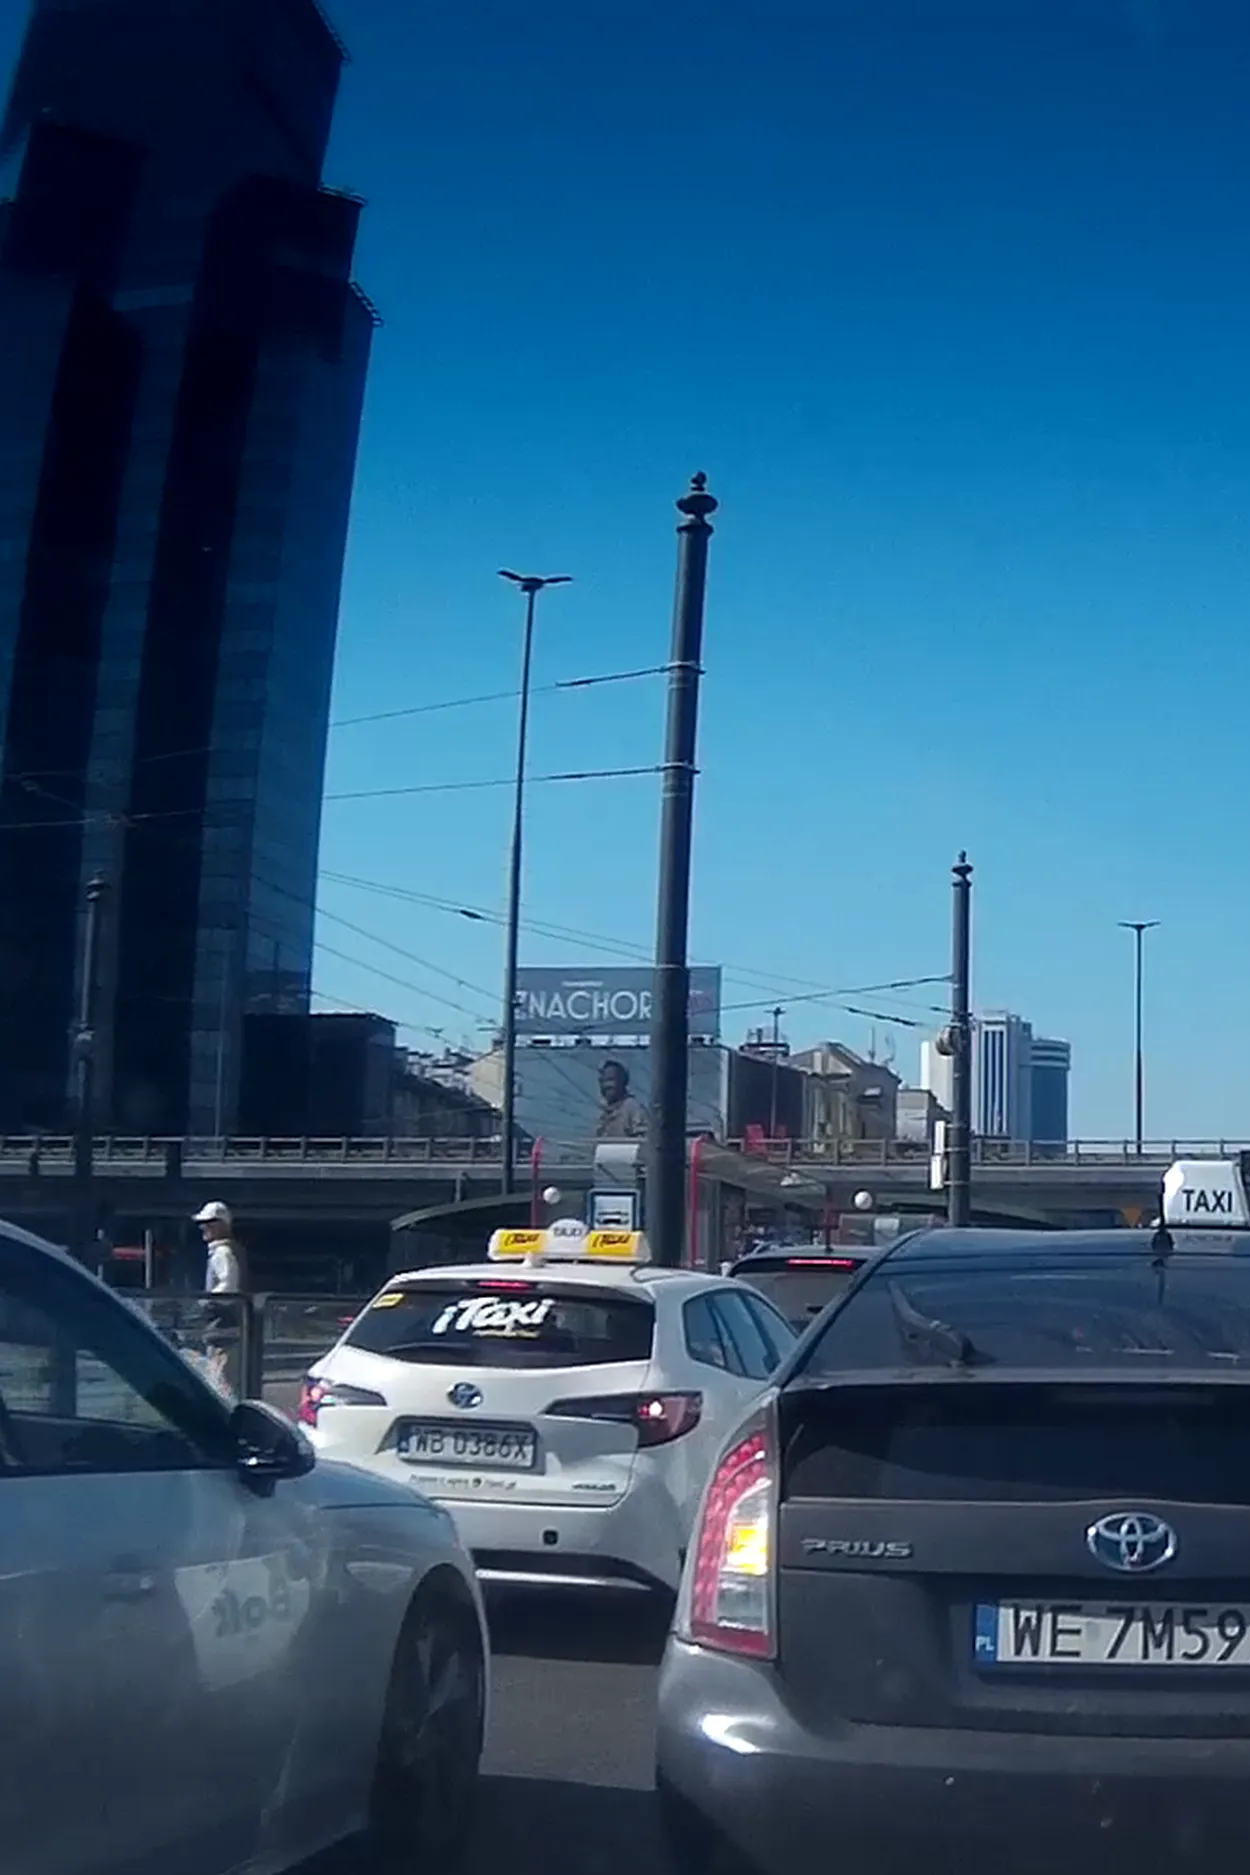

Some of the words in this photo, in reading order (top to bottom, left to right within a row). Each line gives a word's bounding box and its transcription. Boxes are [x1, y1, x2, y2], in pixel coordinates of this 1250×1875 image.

[1181, 1189, 1233, 1213] TAXI
[553, 1226, 583, 1237] TAXI
[432, 1296, 555, 1335] iTaxi
[416, 1429, 444, 1454] WB
[801, 1538, 912, 1558] PRIUS
[975, 1635, 995, 1651] PL
[1012, 1604, 1082, 1658] WE
